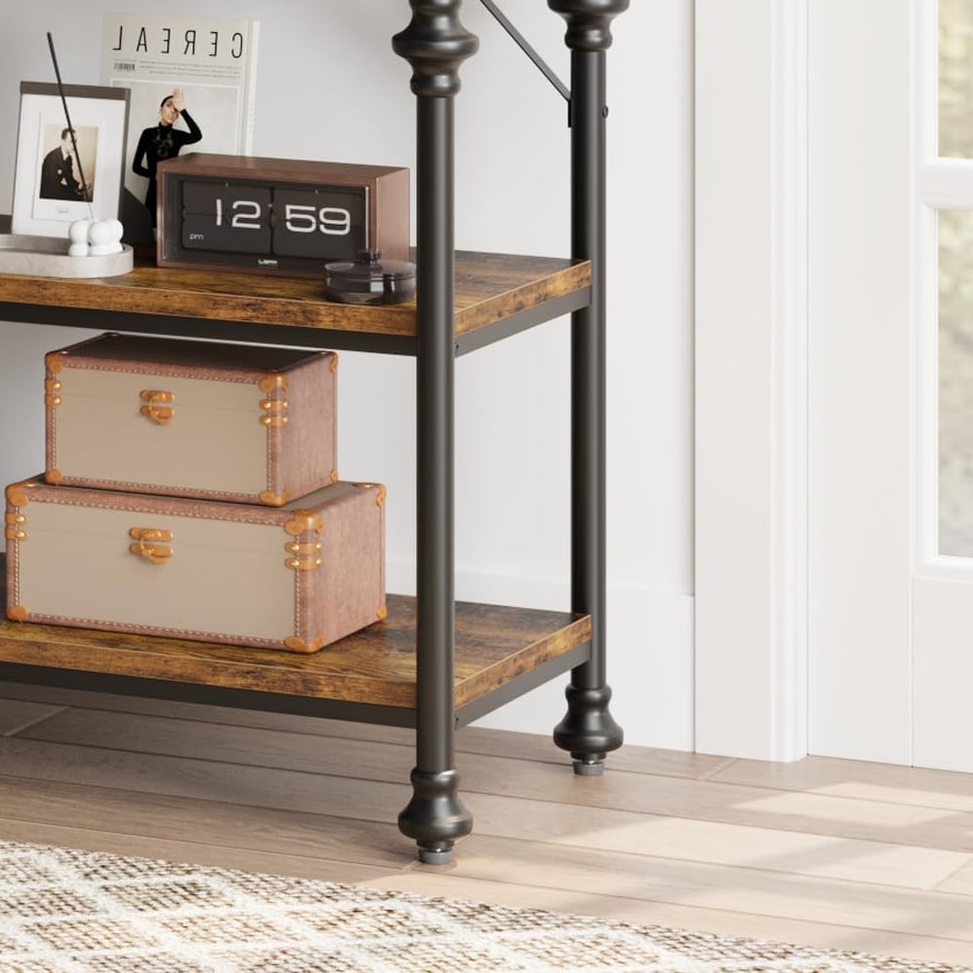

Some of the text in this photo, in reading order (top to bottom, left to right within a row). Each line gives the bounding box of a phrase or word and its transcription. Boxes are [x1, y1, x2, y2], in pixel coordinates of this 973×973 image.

[216, 198, 351, 235] 12 59
[189, 232, 204, 241] pm
